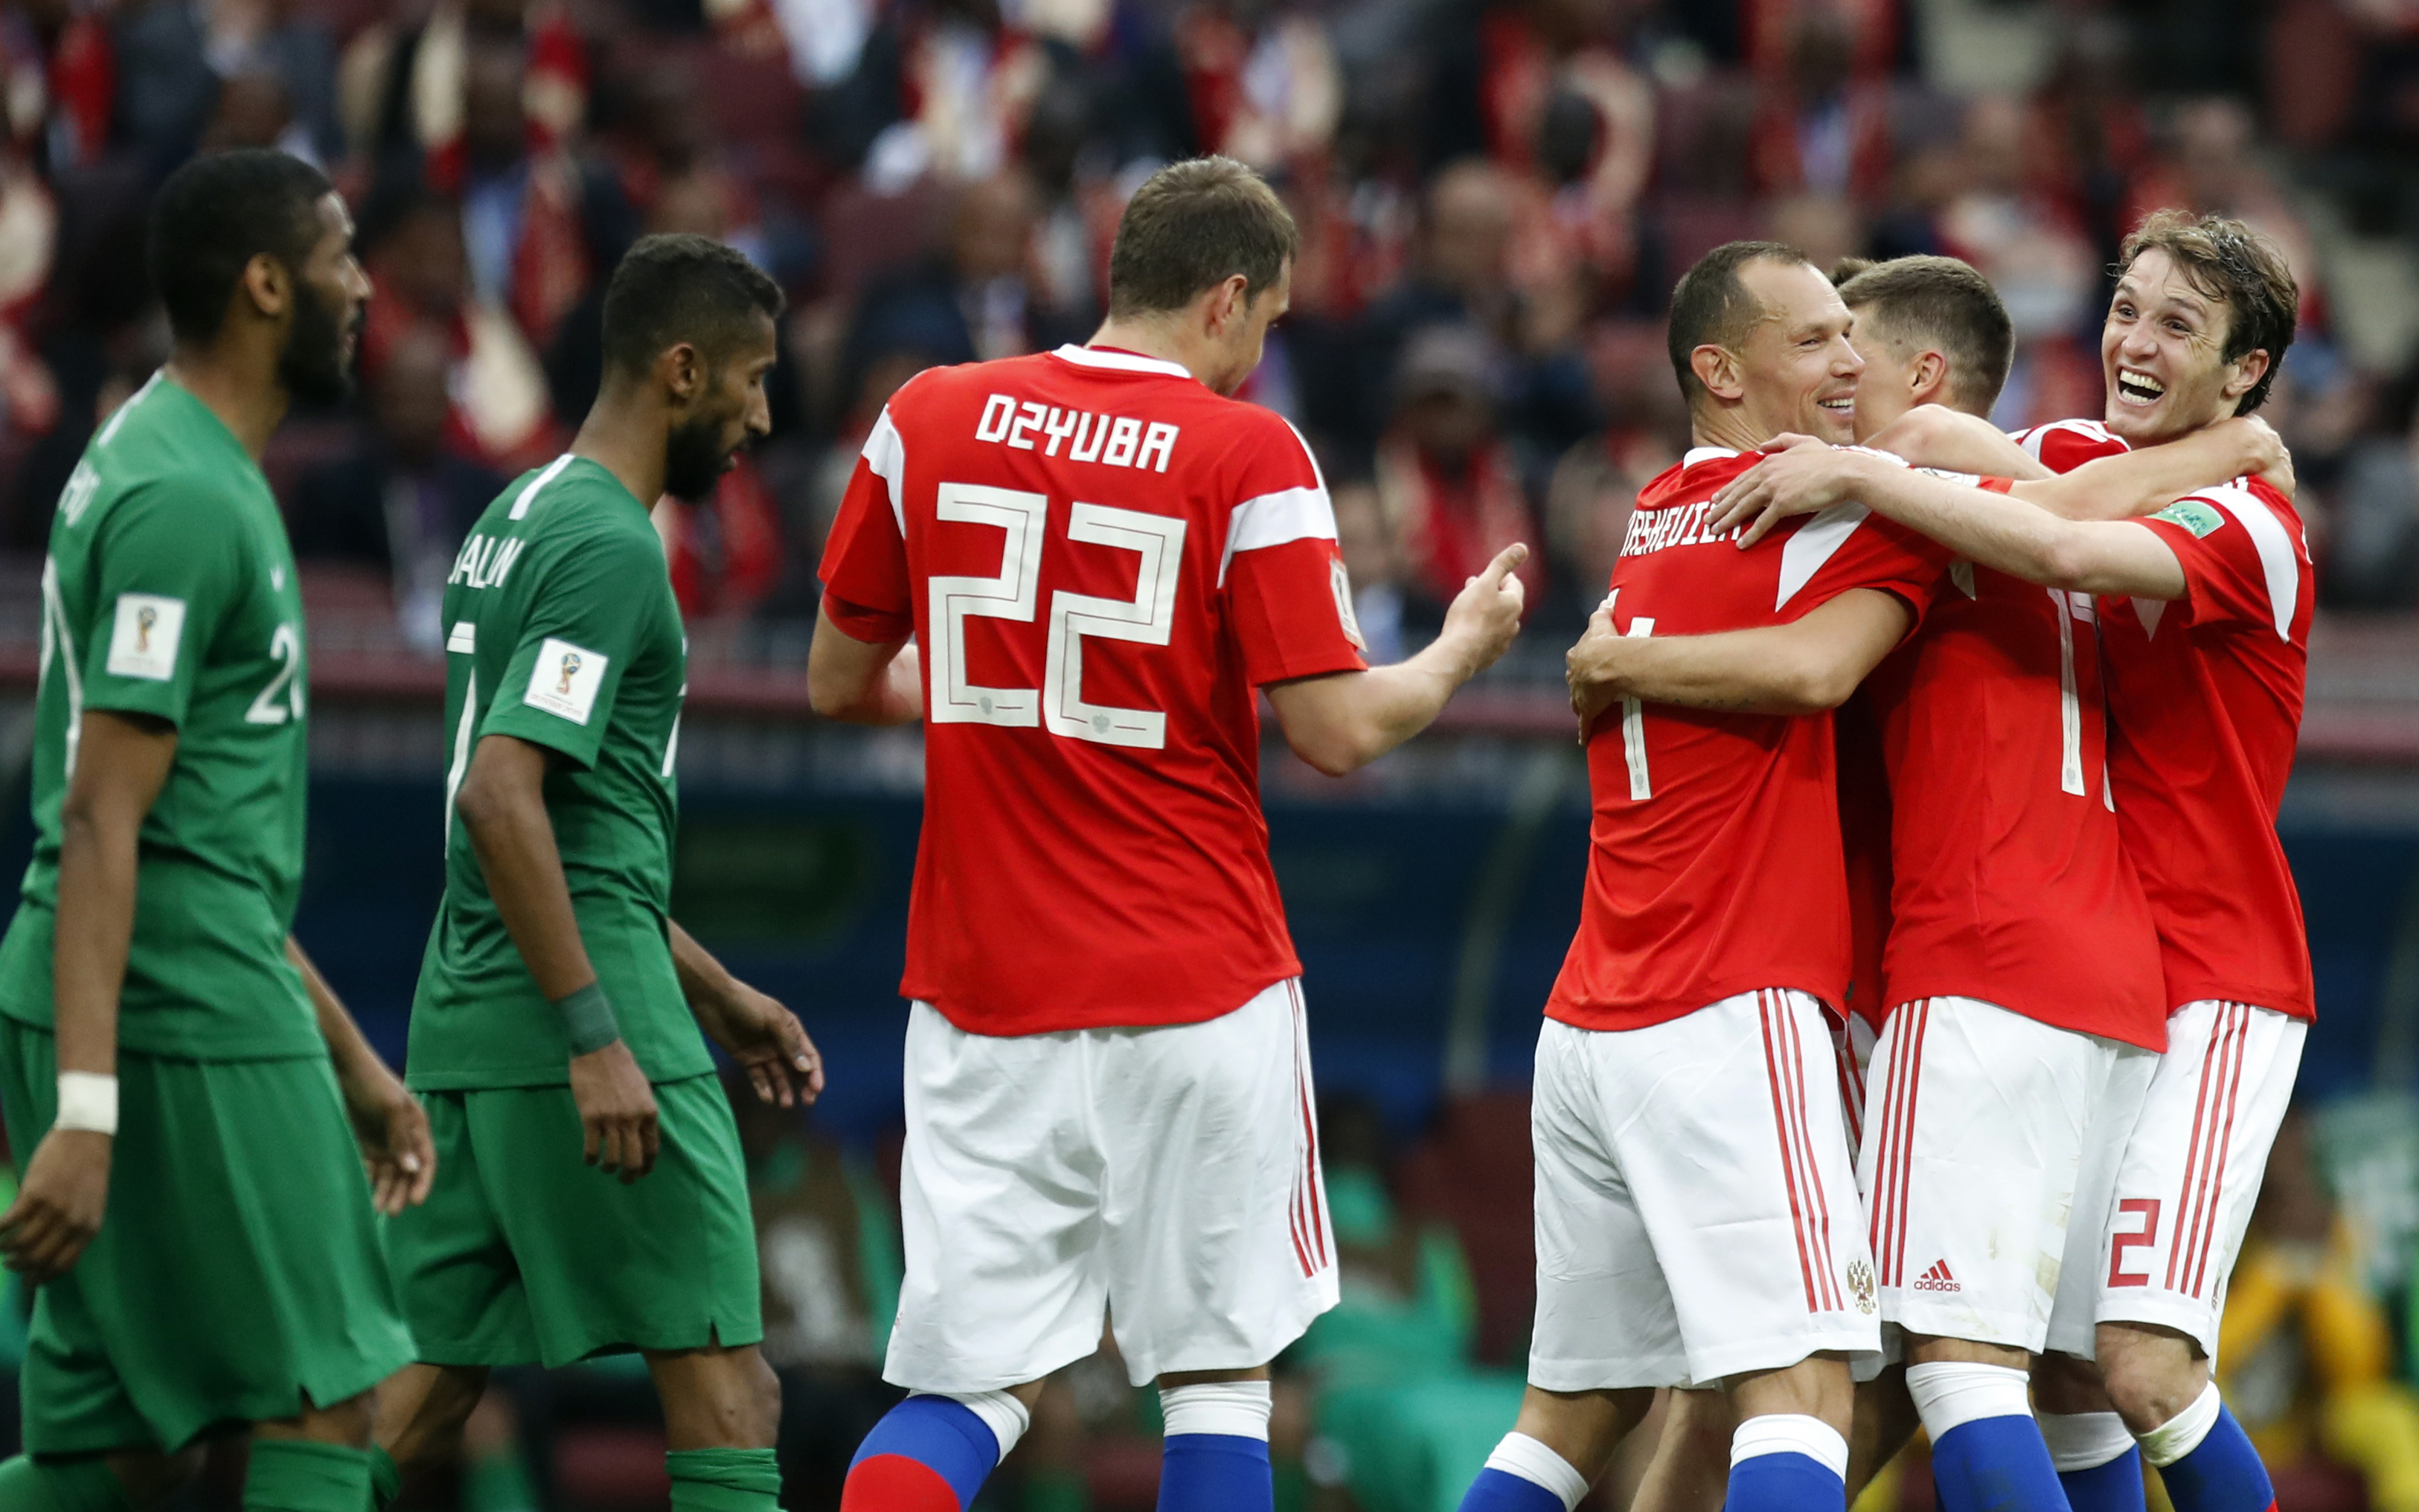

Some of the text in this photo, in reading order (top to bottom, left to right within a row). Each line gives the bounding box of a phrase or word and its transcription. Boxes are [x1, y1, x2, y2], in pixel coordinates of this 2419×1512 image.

[975, 393, 1180, 473] DZYUBA
[928, 481, 1188, 749] 22
[1914, 1278, 1961, 1292] adidas
[2107, 1198, 2161, 1288] 2
